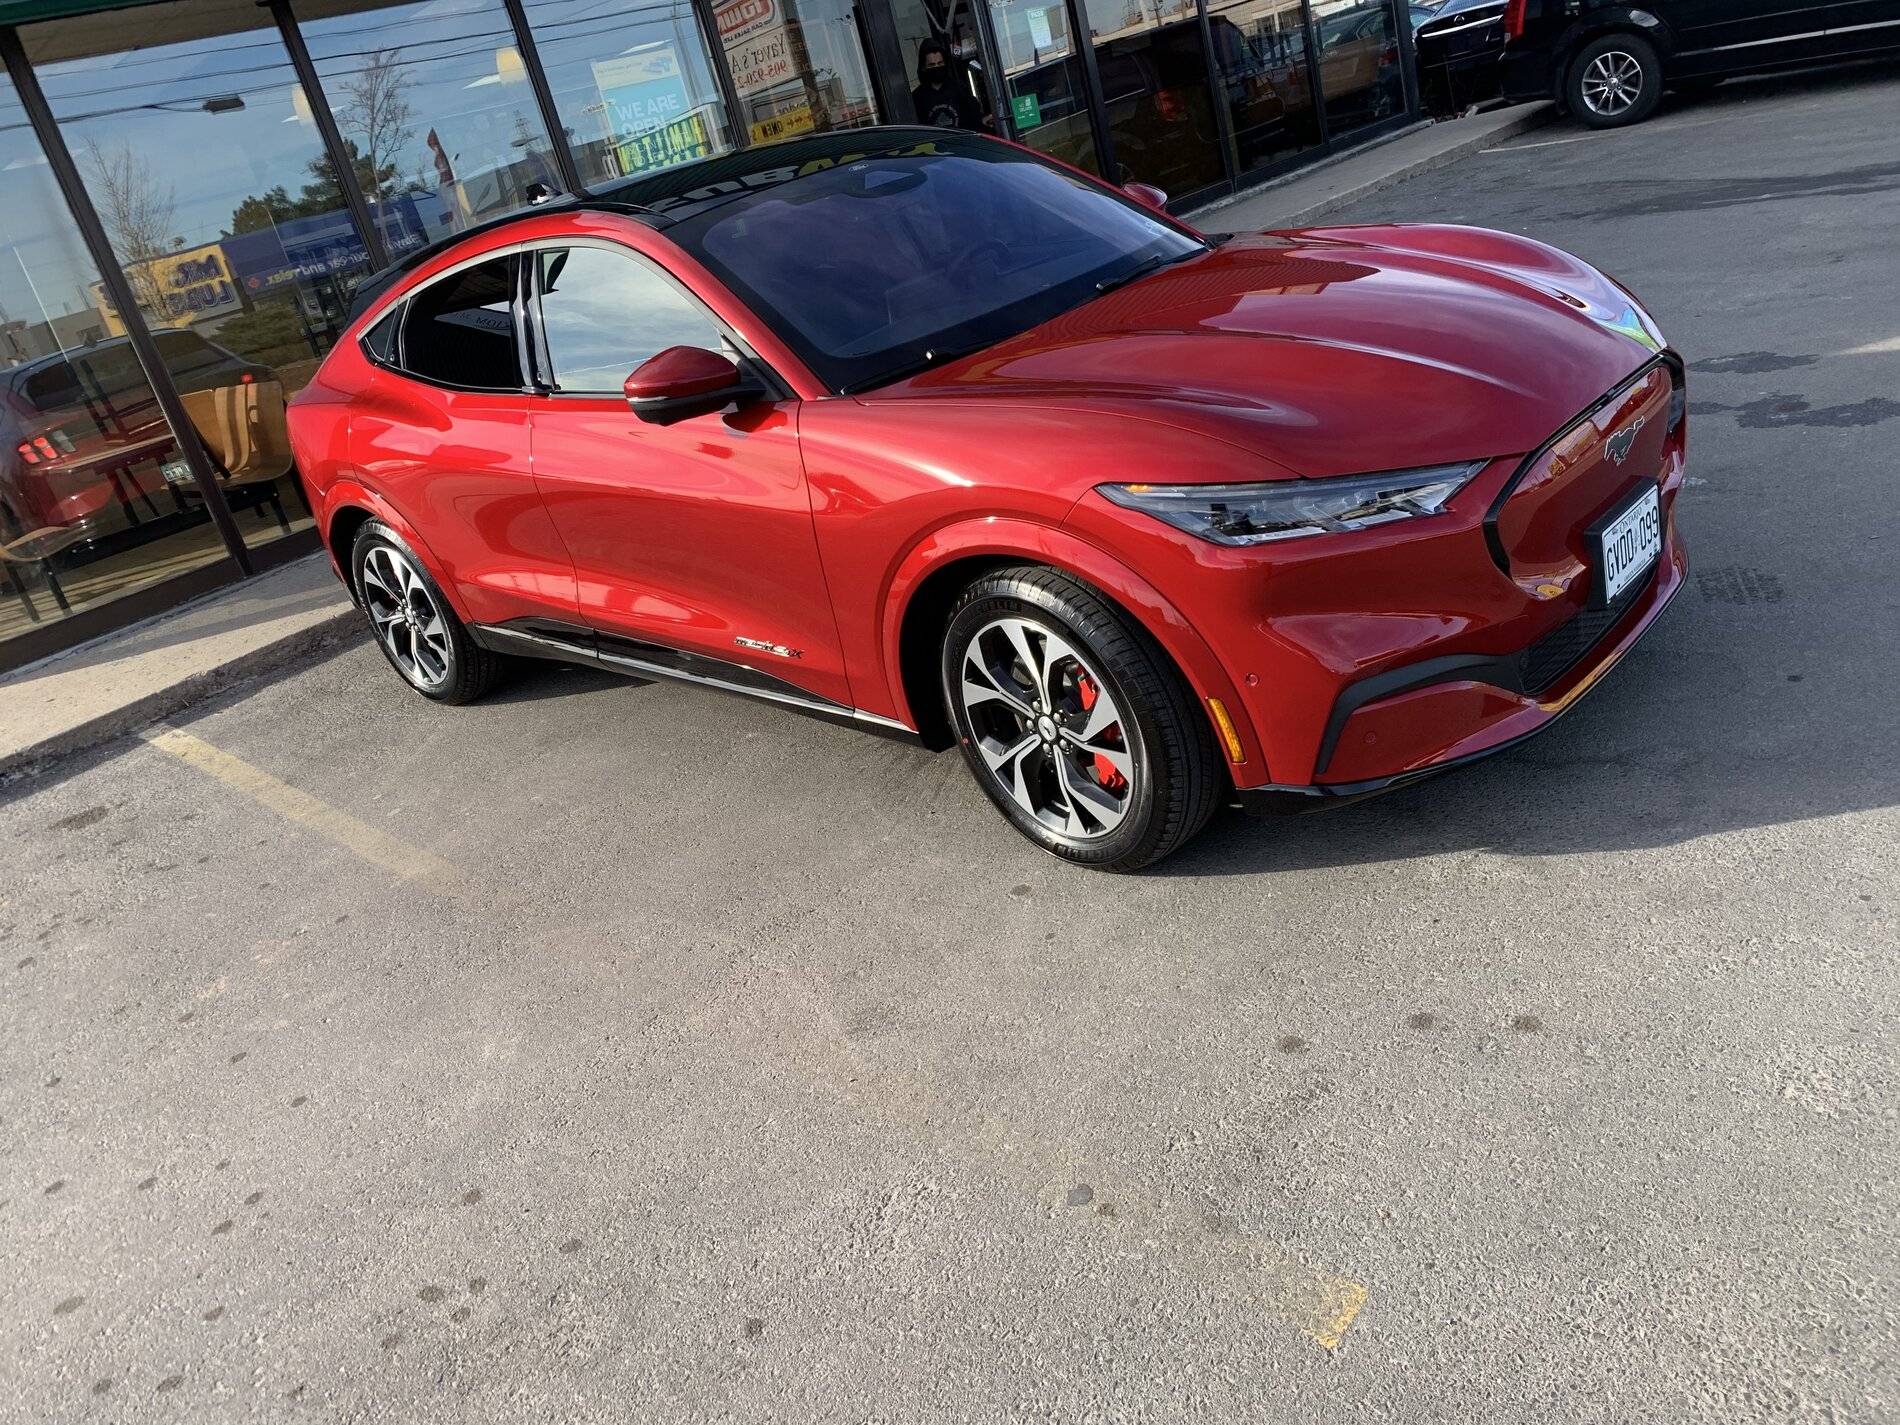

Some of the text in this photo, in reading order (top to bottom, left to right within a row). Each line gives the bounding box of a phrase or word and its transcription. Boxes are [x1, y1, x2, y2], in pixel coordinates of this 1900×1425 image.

[614, 93, 680, 121] WE ARE
[1606, 528, 1635, 582] GVDD
[1638, 505, 1659, 551] 099
